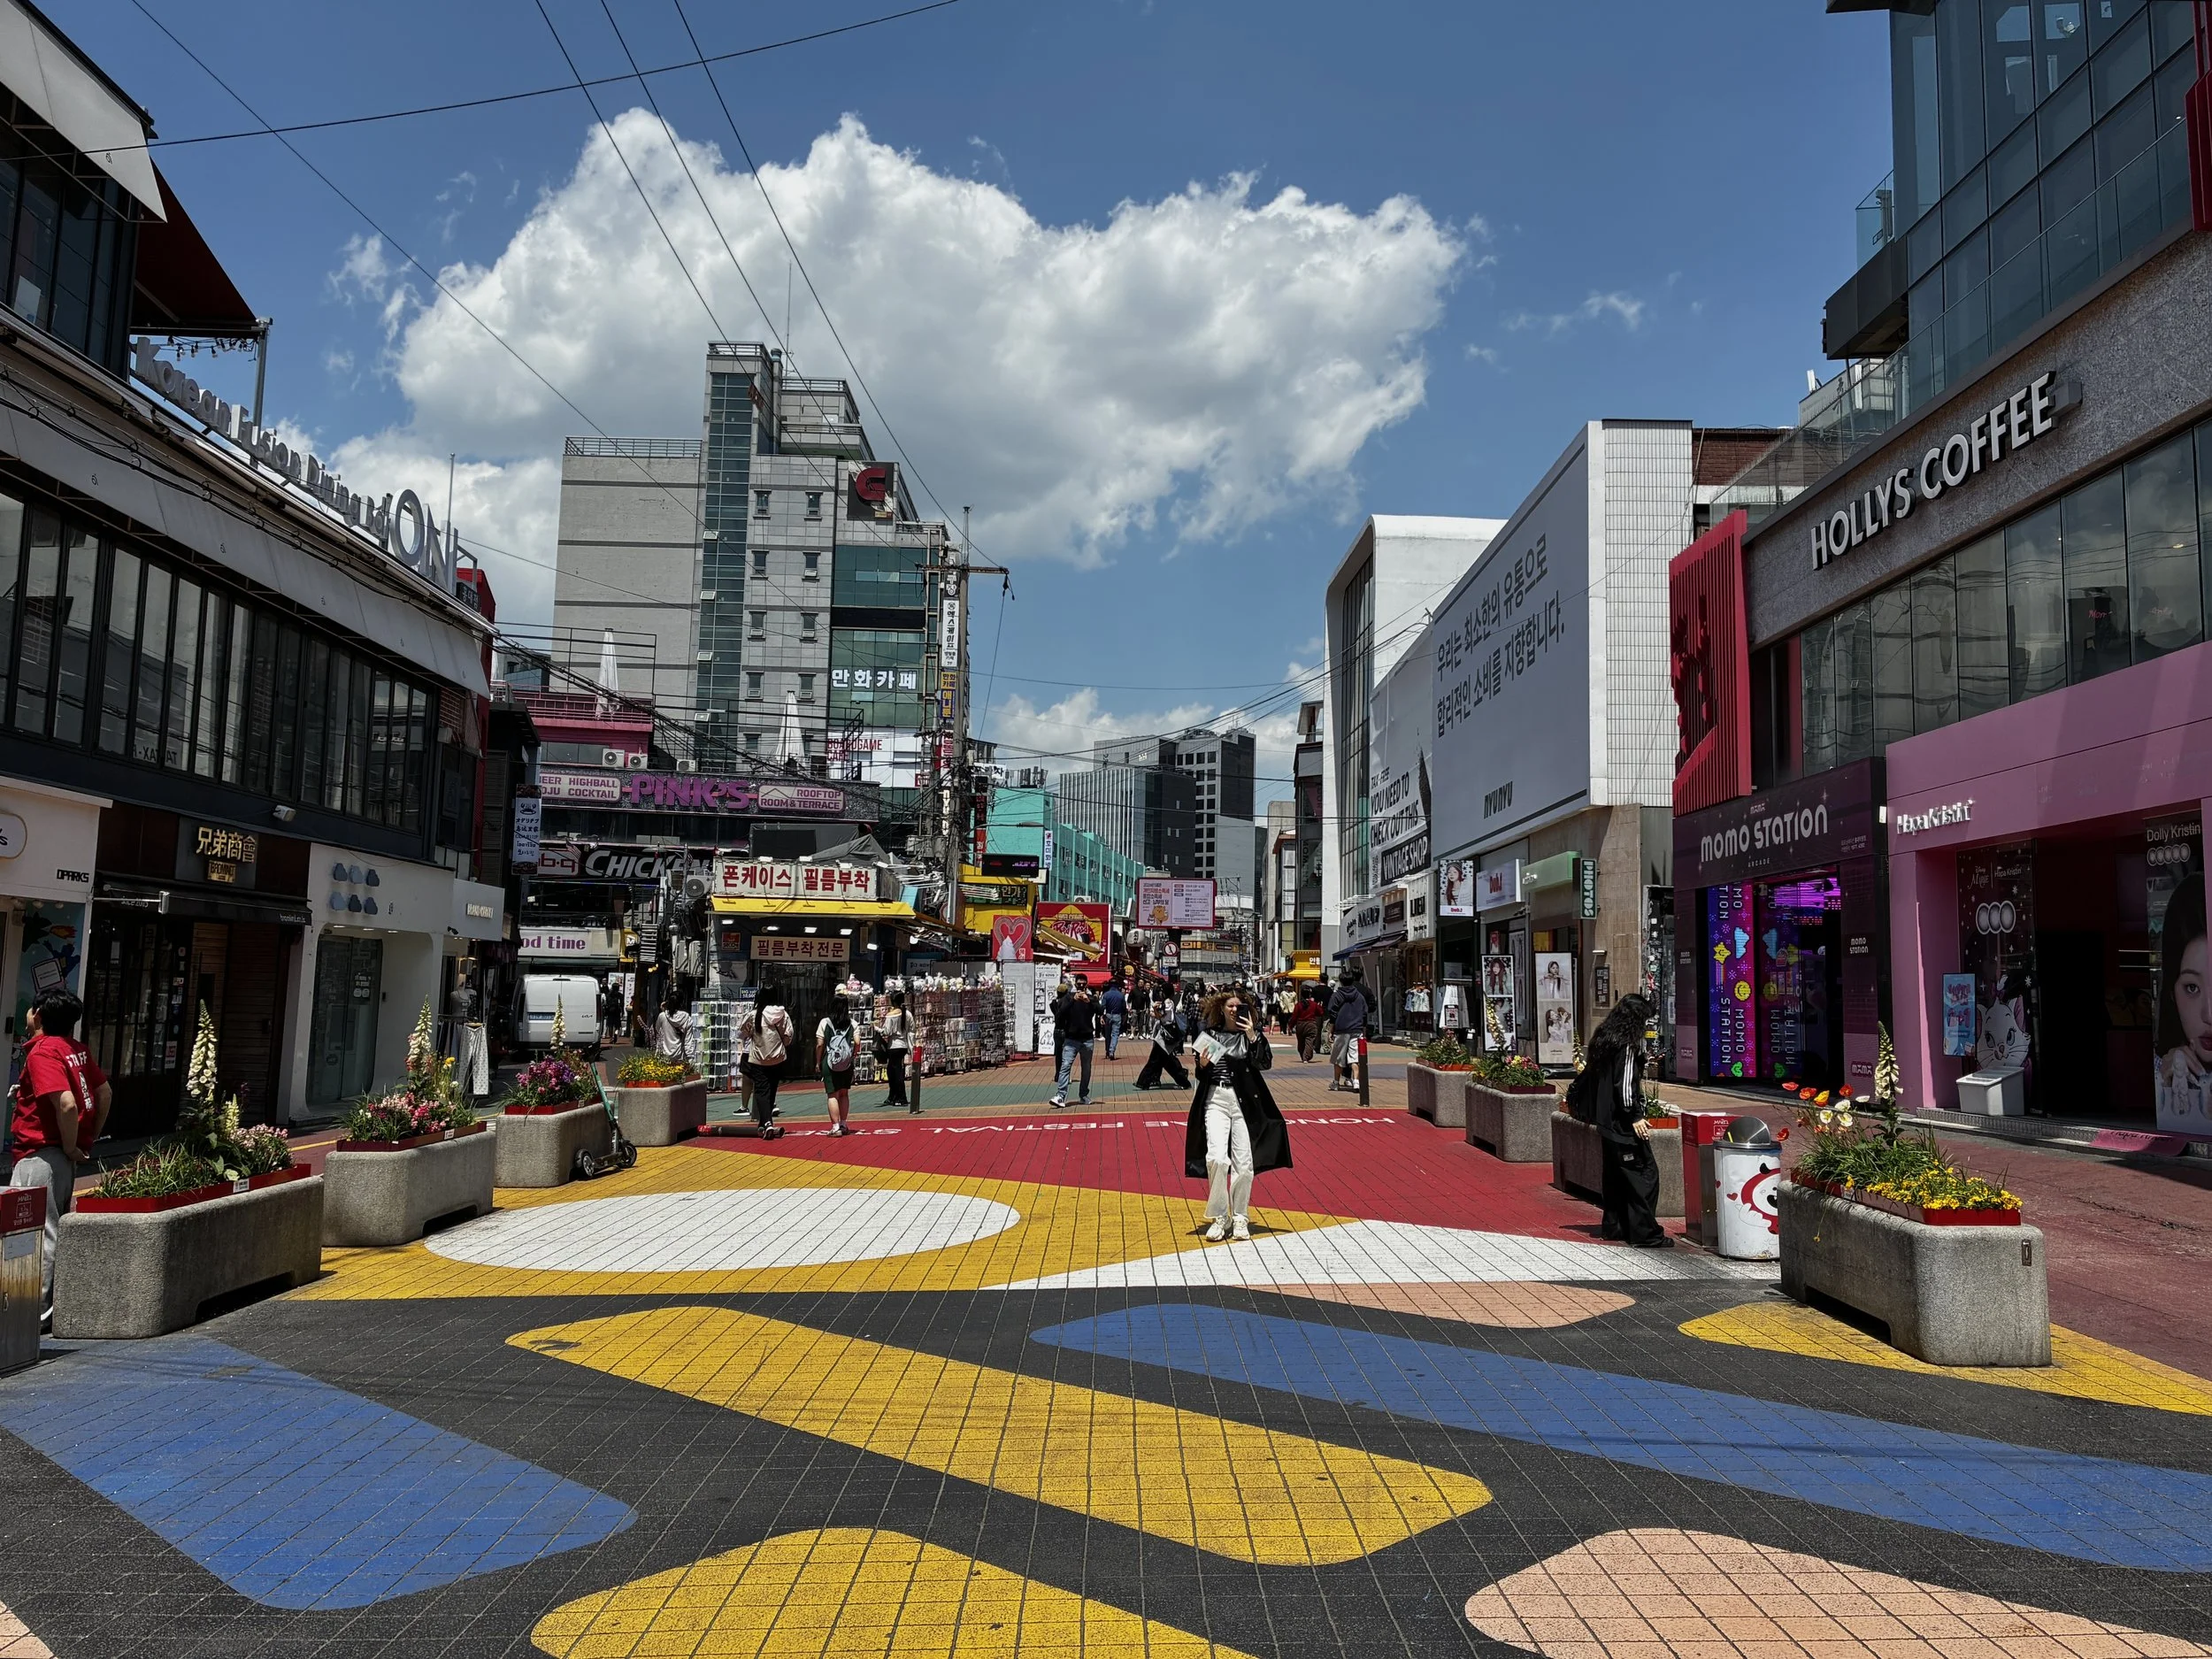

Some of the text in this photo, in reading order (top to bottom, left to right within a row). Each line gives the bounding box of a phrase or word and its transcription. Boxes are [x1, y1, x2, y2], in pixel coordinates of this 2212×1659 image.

[135, 336, 231, 435] Korean
[231, 404, 302, 480] Fusion
[301, 454, 361, 526] Dining
[1811, 372, 2057, 571] HOLLYS COFFEE
[389, 488, 458, 595] ON
[1438, 533, 1548, 681] 우리는 최소한의 유통으로
[832, 669, 918, 690] 만화카페
[1438, 590, 1565, 738] 합리적인 소비를 지향합니다.
[541, 787, 618, 799] OJU COCKTAIL
[569, 777, 618, 788] HIGHBALL
[630, 773, 750, 810] PINK'S
[797, 788, 841, 799] ROOFTOP
[1371, 771, 1410, 817] YOU NEED TO
[1371, 799, 1419, 849] CHECK OUT THIS
[1754, 803, 1828, 849] STATION
[2147, 822, 2201, 842] Dolly Kristin
[196, 826, 257, 864] 兄弟商會
[1409, 835, 1428, 872] SHOP
[1748, 857, 1770, 868] ARCADE
[722, 863, 870, 893] 폰케이스 필름부착
[1583, 860, 1594, 917] PHOTOS
[520, 935, 586, 950] od time
[757, 939, 814, 957] 필름부착
[817, 940, 844, 958] 전문
[1720, 997, 1732, 1064] STATION
[1734, 1009, 1746, 1053] MOMO
[920, 1121, 1125, 1133] FESTIVAL
